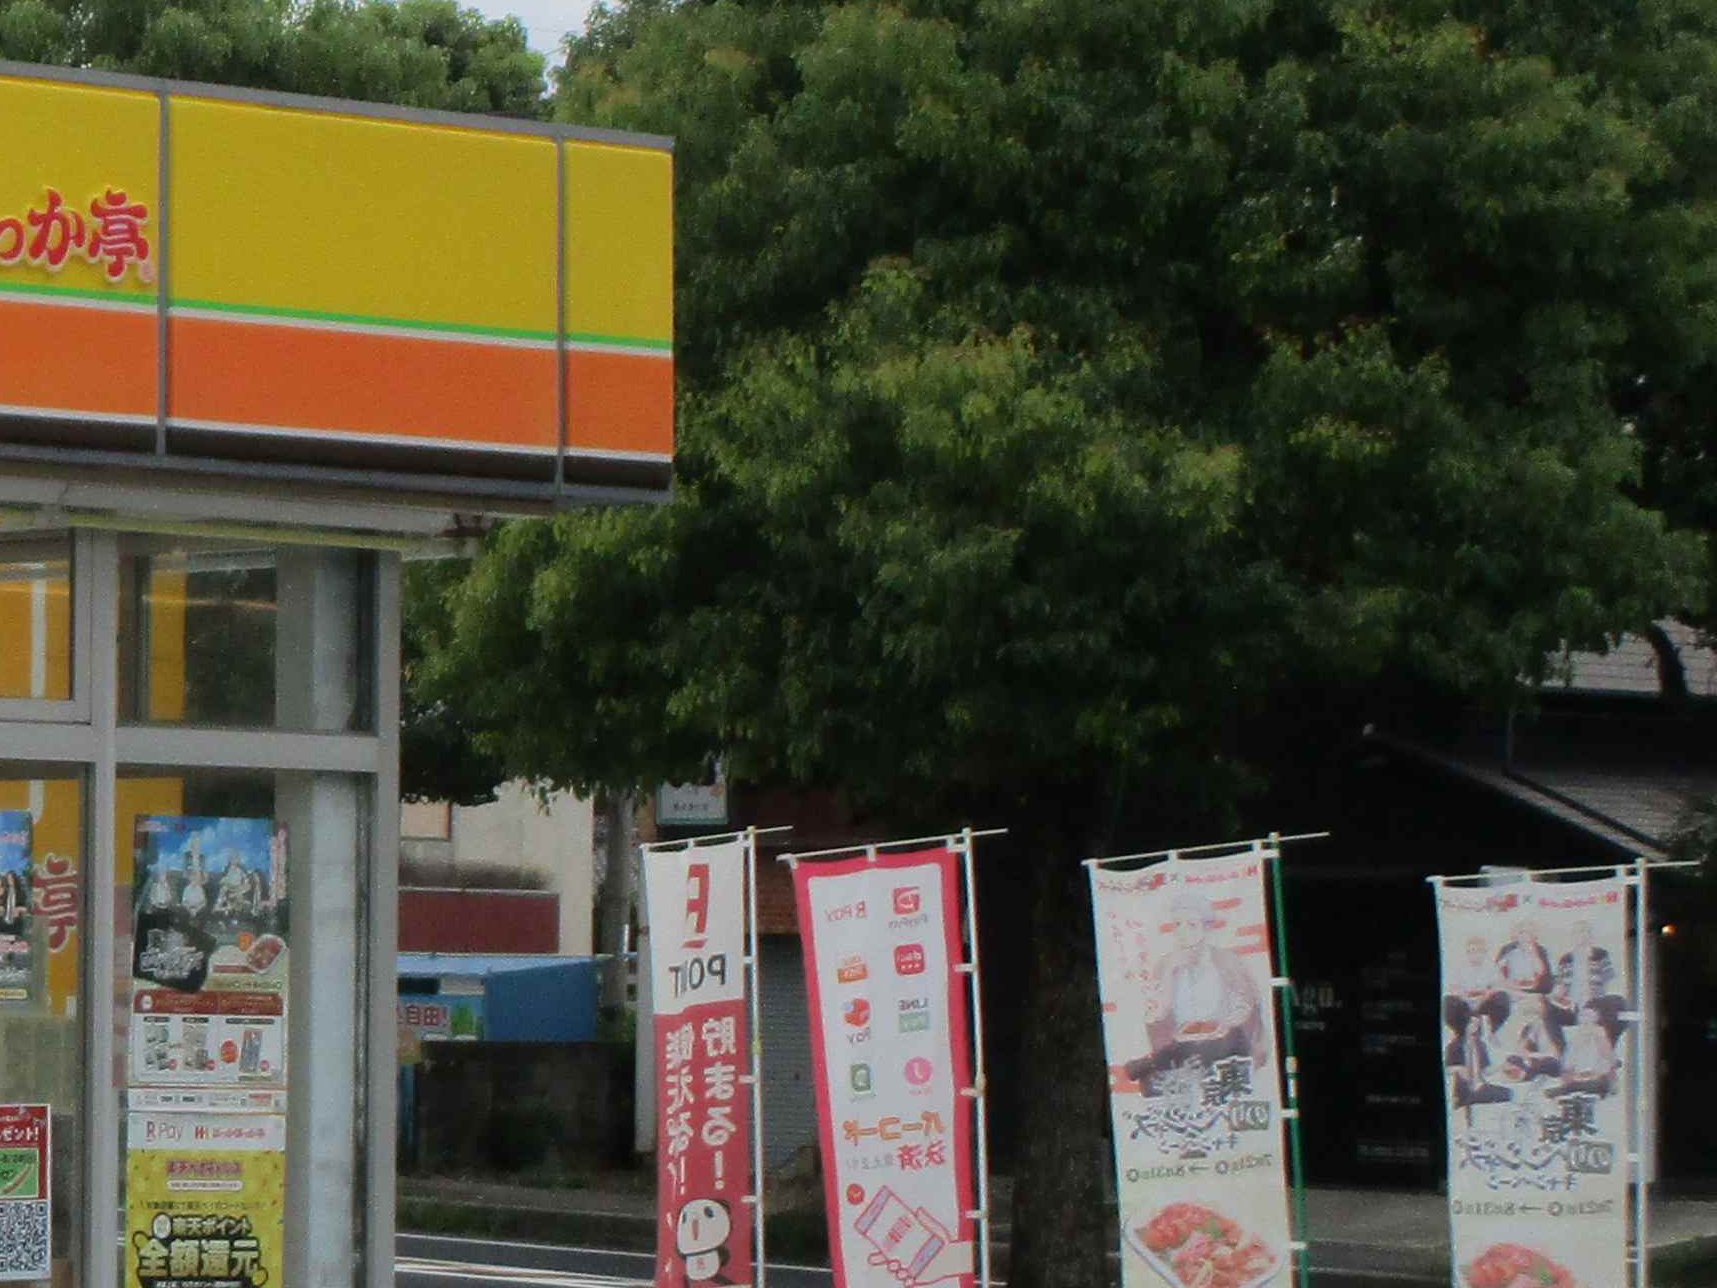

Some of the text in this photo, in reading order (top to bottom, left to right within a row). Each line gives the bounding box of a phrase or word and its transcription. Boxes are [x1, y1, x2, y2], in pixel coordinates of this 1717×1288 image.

[159, 1123, 184, 1142] Pay
[171, 1215, 251, 1237] 楽天ポイント
[138, 1237, 260, 1278] 全額還元
